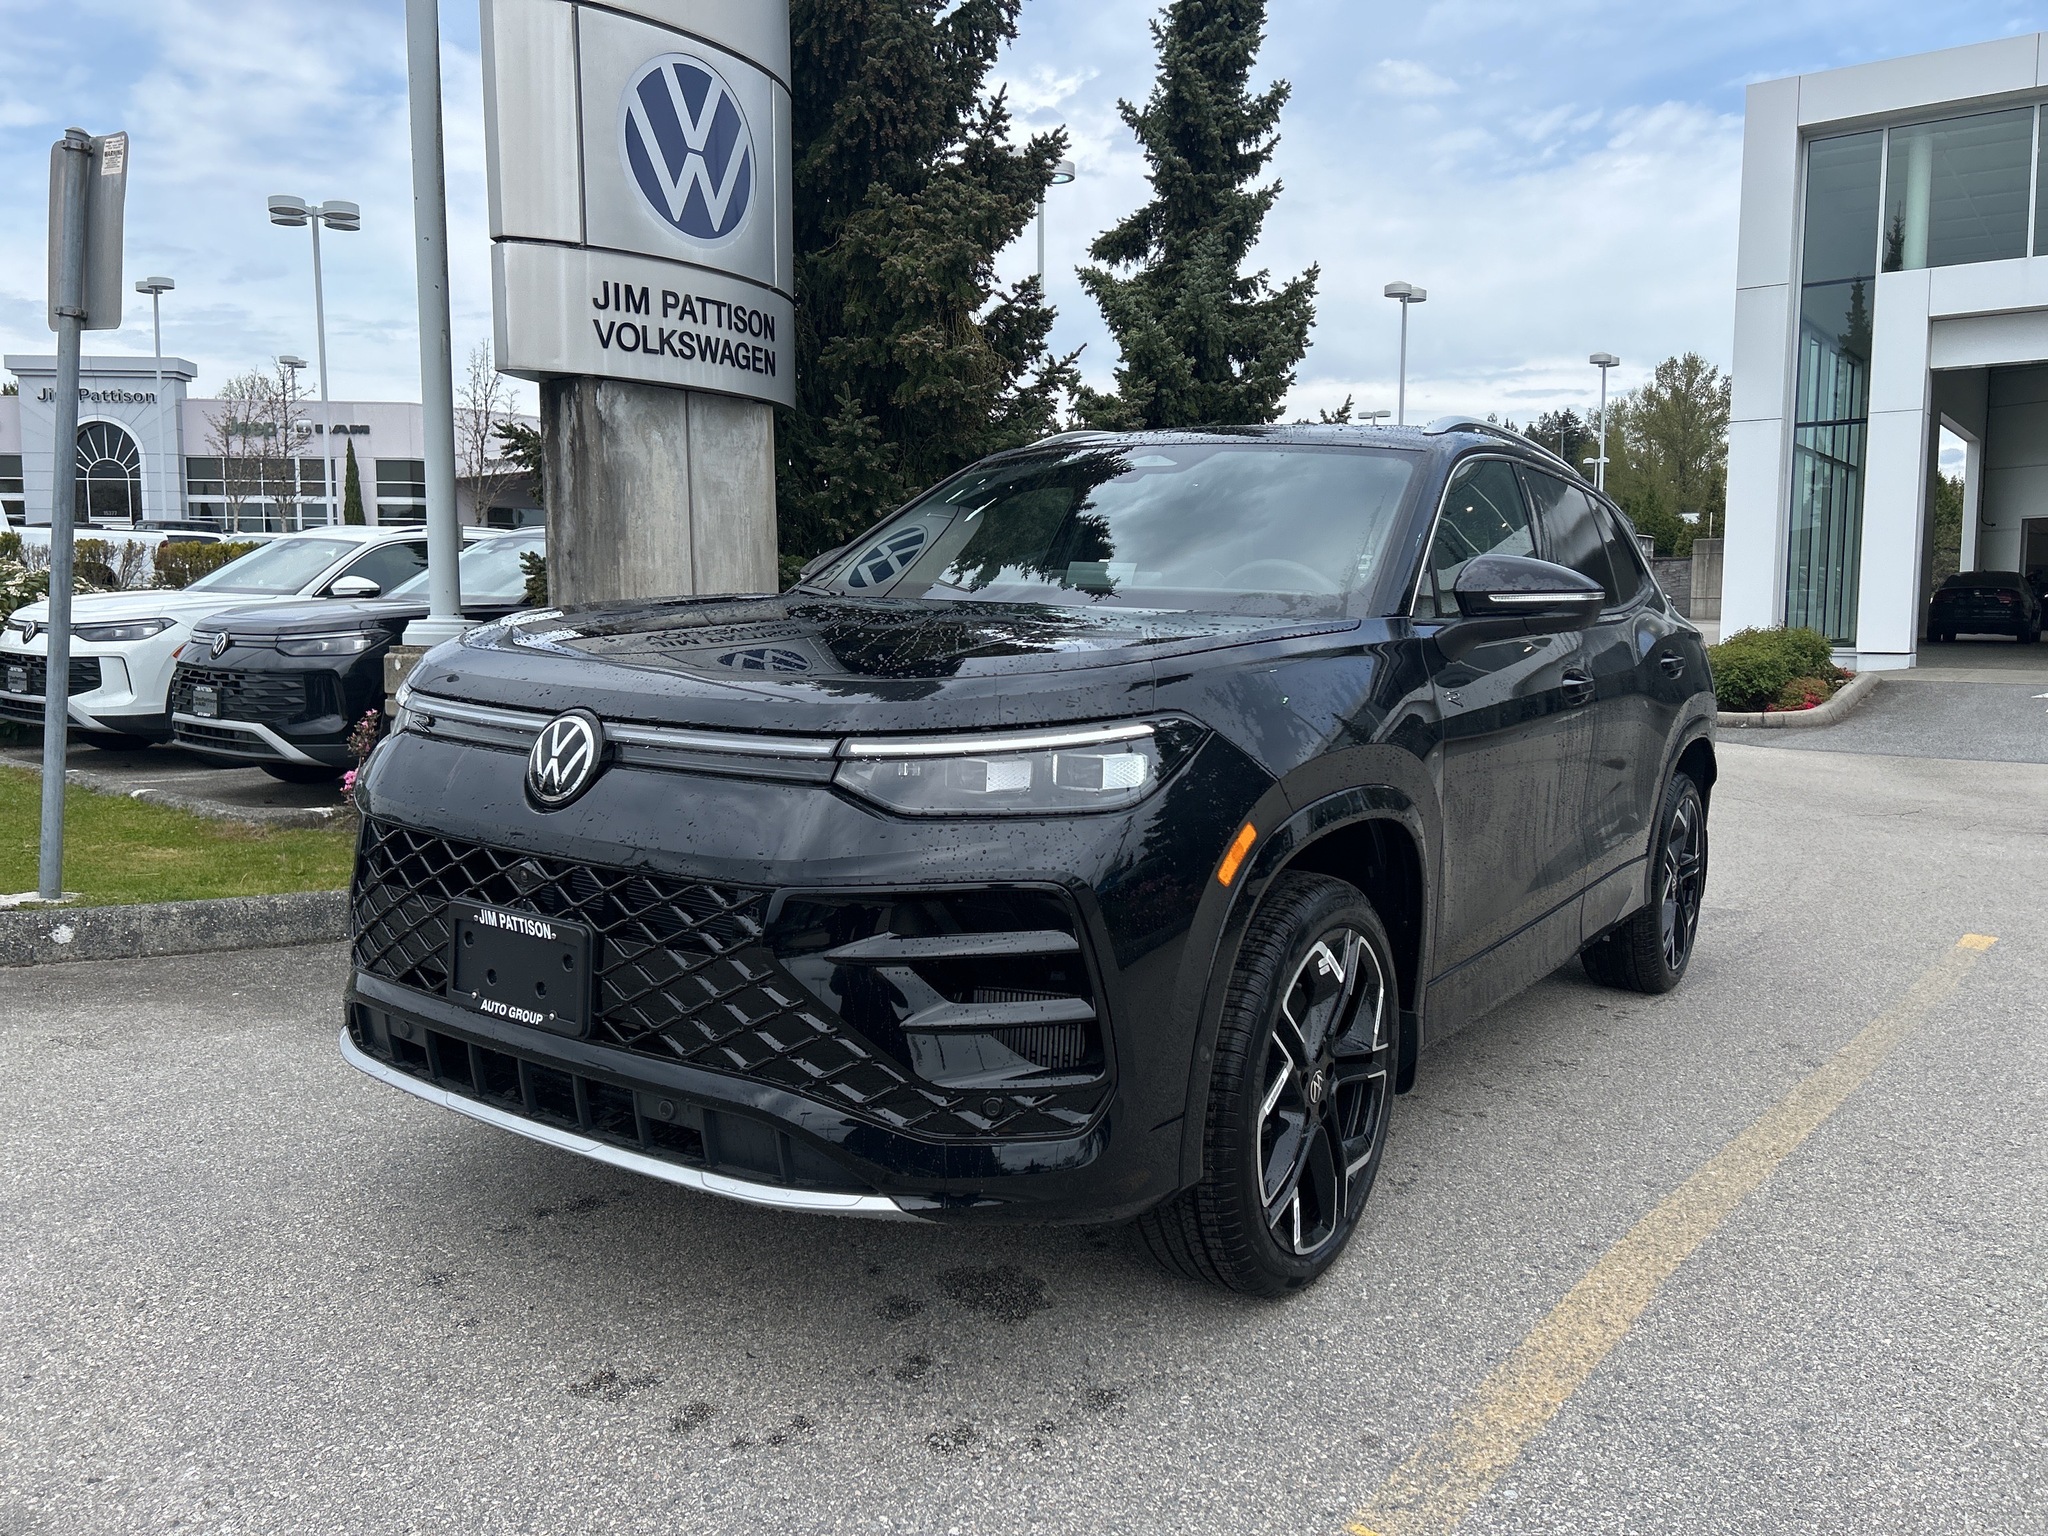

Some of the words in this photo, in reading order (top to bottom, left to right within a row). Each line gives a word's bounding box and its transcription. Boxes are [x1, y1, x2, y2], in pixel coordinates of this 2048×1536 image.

[592, 280, 650, 316] JIM
[661, 289, 776, 343] PATTISON
[592, 318, 776, 377] VOLKSWAGEN
[78, 387, 157, 403] Pattison
[478, 909, 498, 928] JIM
[499, 913, 552, 940] PATTISON
[480, 999, 507, 1016] AUTO
[508, 1006, 544, 1026] GROUP
